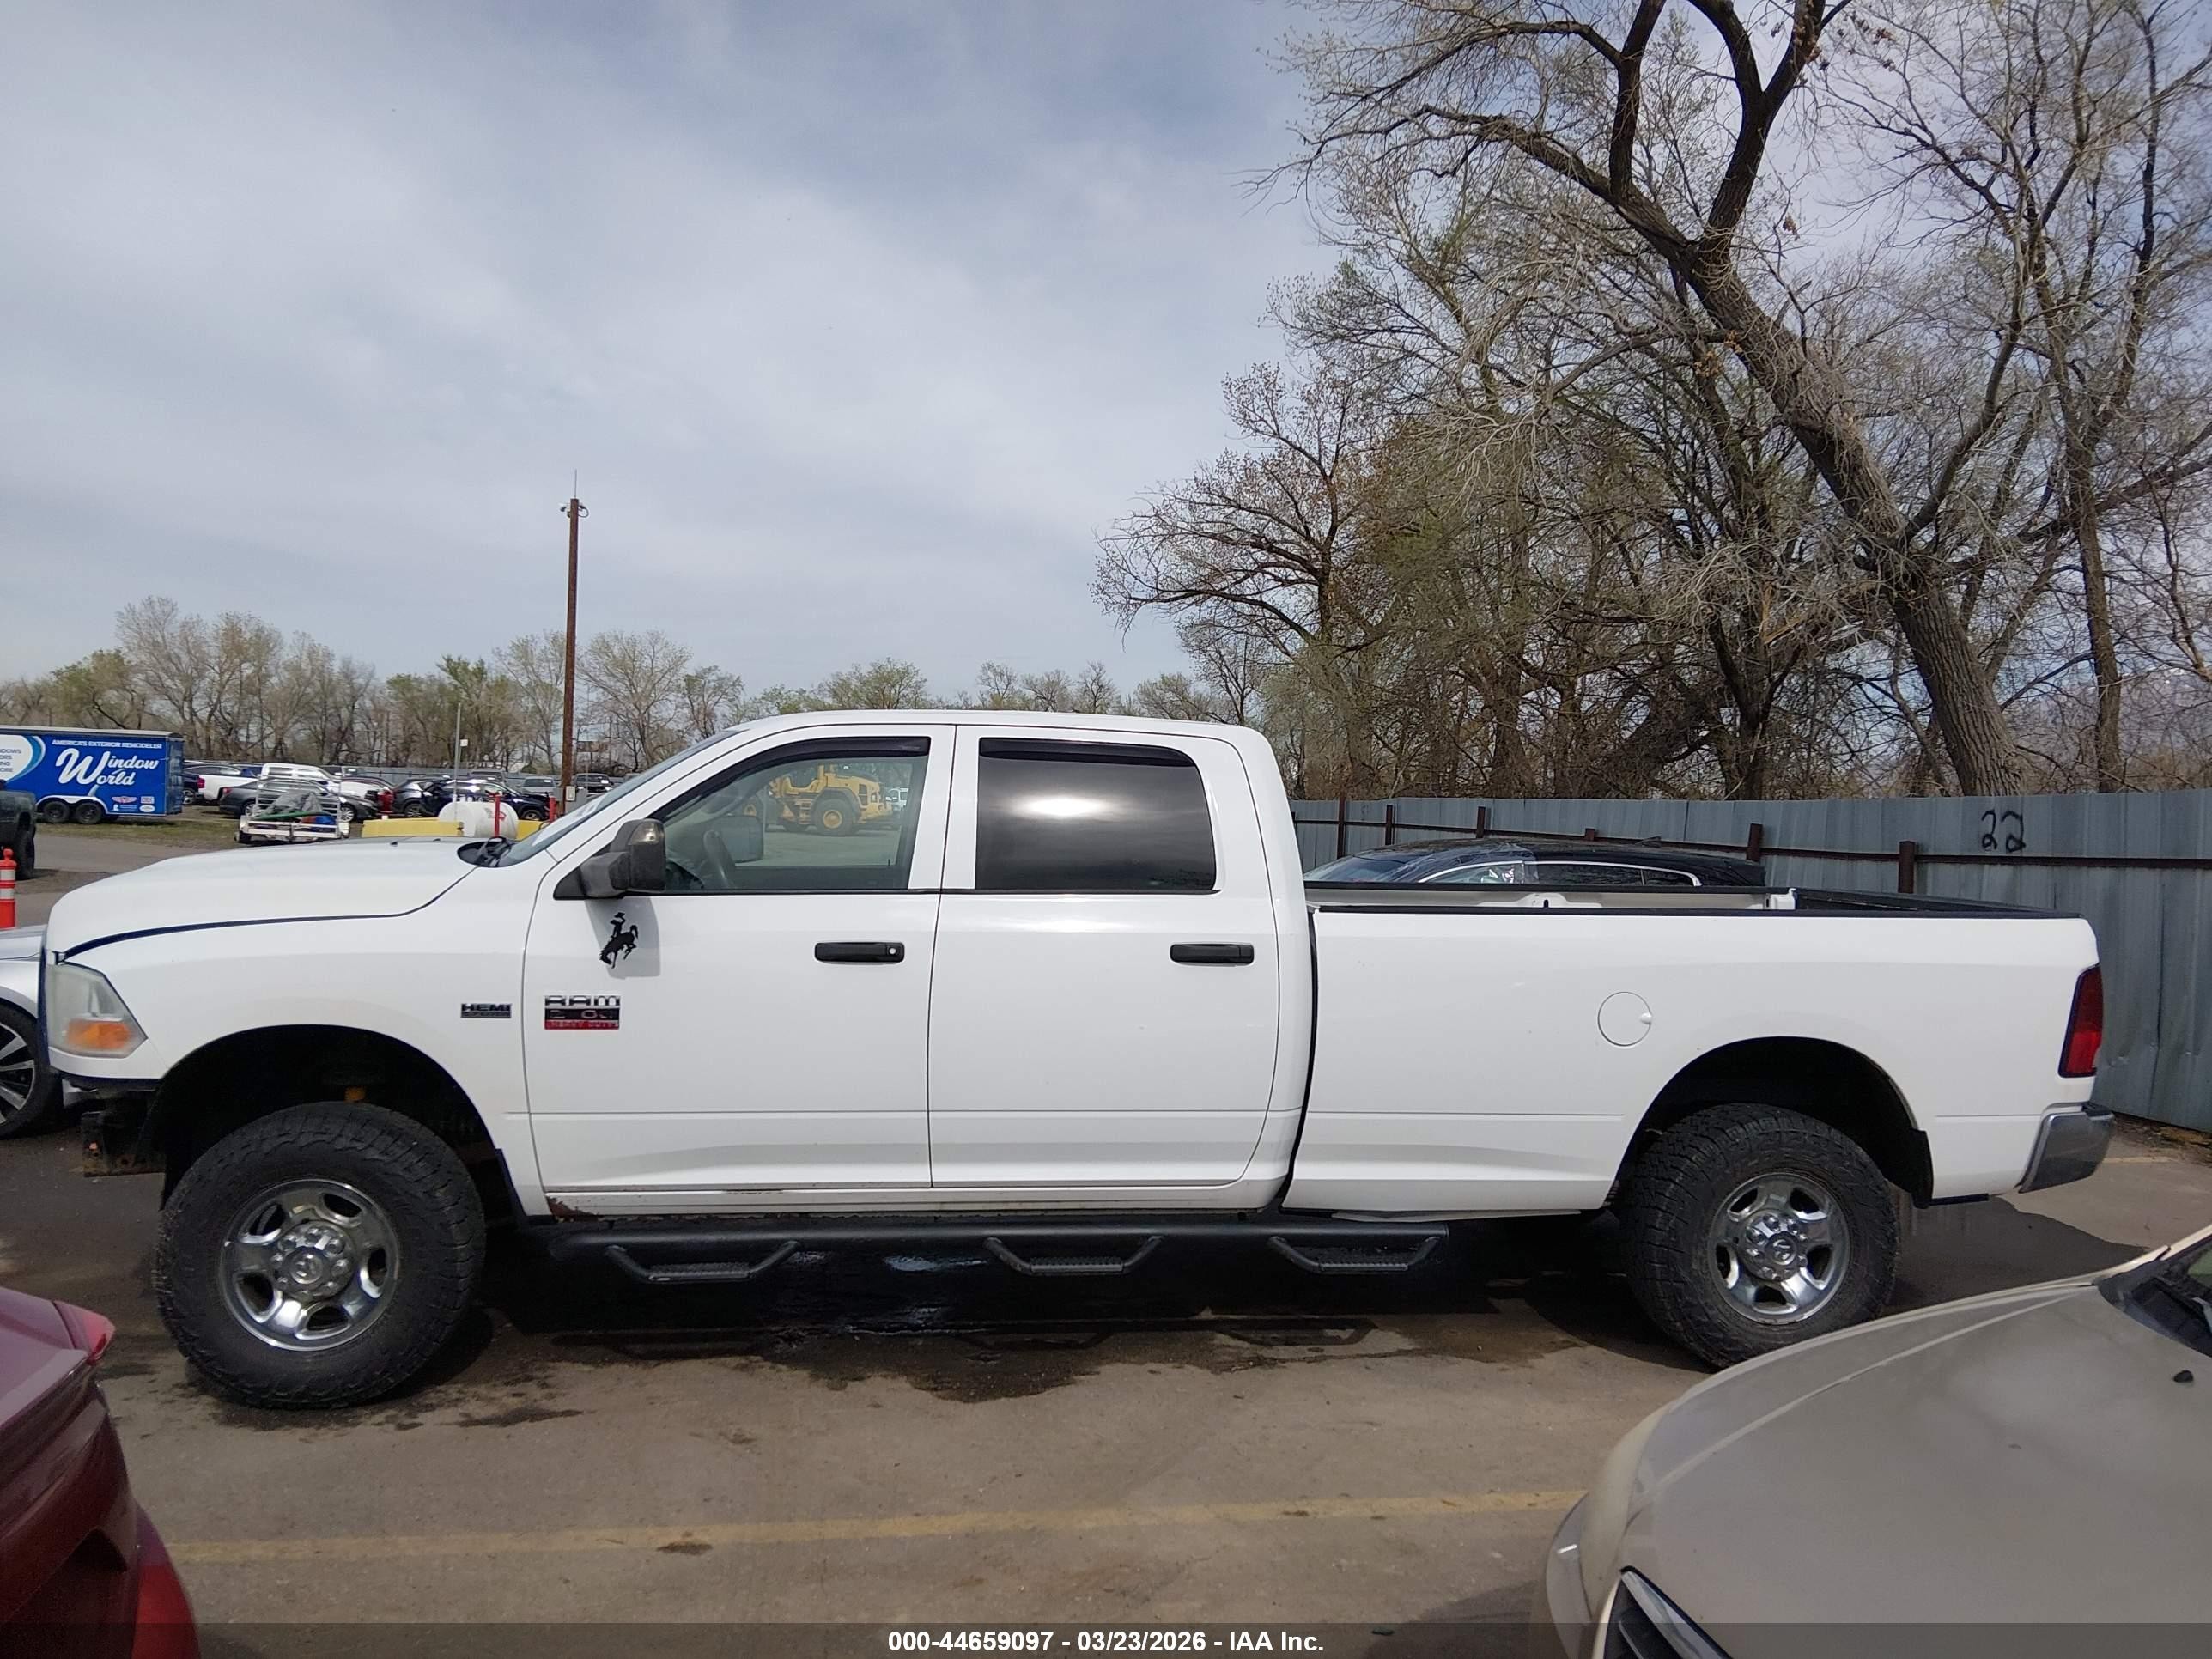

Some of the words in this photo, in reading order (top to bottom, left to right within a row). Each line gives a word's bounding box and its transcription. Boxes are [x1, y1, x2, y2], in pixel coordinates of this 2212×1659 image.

[55, 748, 159, 785] Window
[1981, 809, 2027, 853] 22
[460, 1003, 512, 1012] HEMI
[544, 995, 620, 1006] RAM
